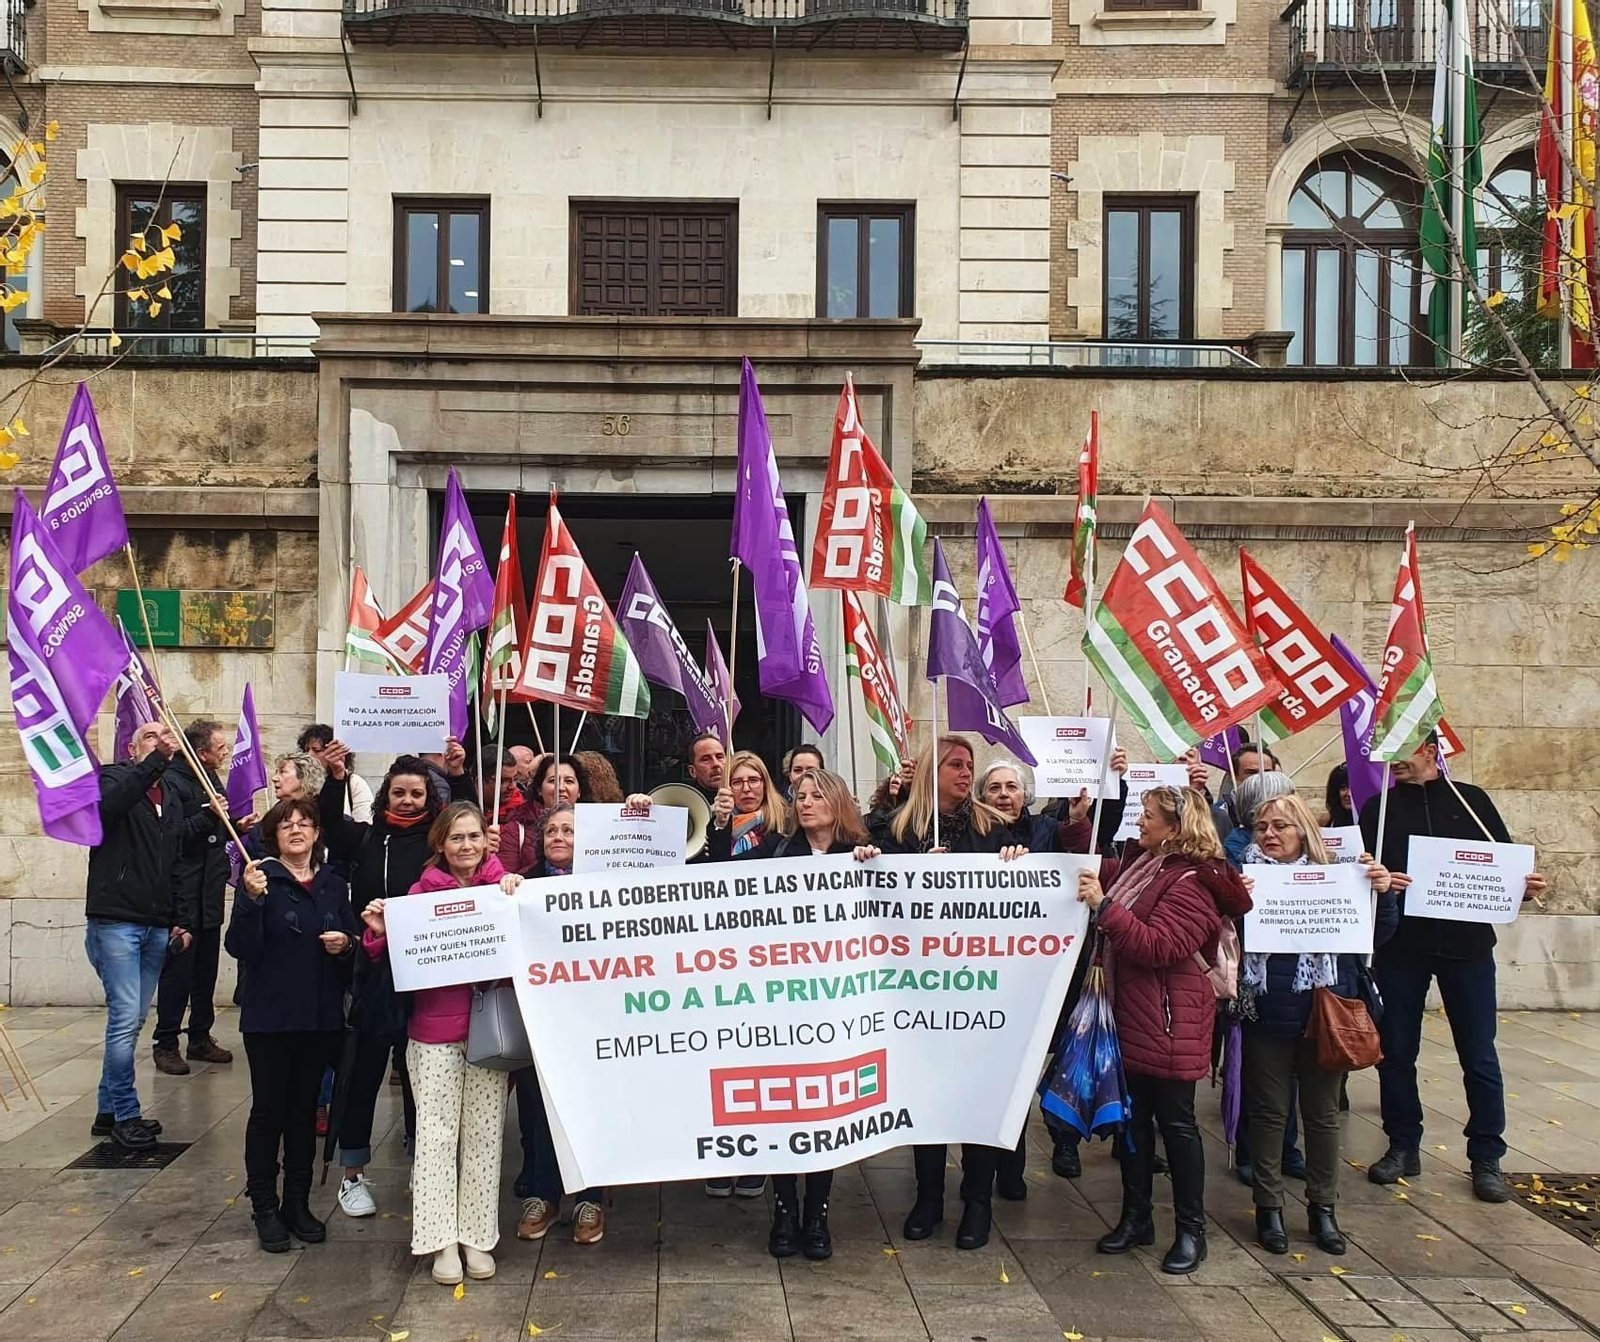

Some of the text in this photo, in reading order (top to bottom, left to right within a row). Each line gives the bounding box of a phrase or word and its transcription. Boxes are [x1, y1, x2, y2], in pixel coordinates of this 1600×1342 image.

[603, 414, 630, 436] 56
[1123, 517, 1265, 709] CCOO
[1146, 619, 1219, 723] Granada
[380, 707, 436, 715] AMORTIZACIÓN
[402, 720, 445, 728] JUBILACIÓN
[610, 834, 652, 842] APOSTAMOS
[646, 848, 676, 858] PÚBLICO
[1436, 880, 1446, 888] DE
[1466, 883, 1506, 892] CENTROS
[1465, 874, 1502, 882] VACIADO
[545, 869, 1062, 913] POR LA COBERTURA DE LAS VACANTES Y SUSTITUCIONES
[1428, 890, 1488, 900] DEPENDIENTES
[1280, 898, 1342, 906] SUSTITUCIONES
[1258, 908, 1306, 916] COBERTURA
[1308, 908, 1319, 916] DE
[562, 900, 1048, 943] DEL PERSONAL LABORAL DE LA JUNTA DE ANDALUCIA.
[1280, 926, 1340, 934] PRIVATIZACIÓN
[414, 924, 495, 942] SIN FUNCIONARIOS
[405, 934, 506, 956] NO HAY QUIEN TRAMITE
[417, 948, 497, 966] CONTRATACIONES
[528, 955, 656, 986] SALVAR
[676, 947, 738, 974] LOS
[748, 934, 911, 967] SERVICIOS
[624, 966, 998, 1014] NO A LA PRIVATIZACIÓN
[596, 1010, 1006, 1060] EMPLEO PÚBLICO Y DE CALIDAD
[723, 1069, 856, 1114] CCOO
[696, 1134, 758, 1160] FSC
[788, 1108, 914, 1155] GRANADA
